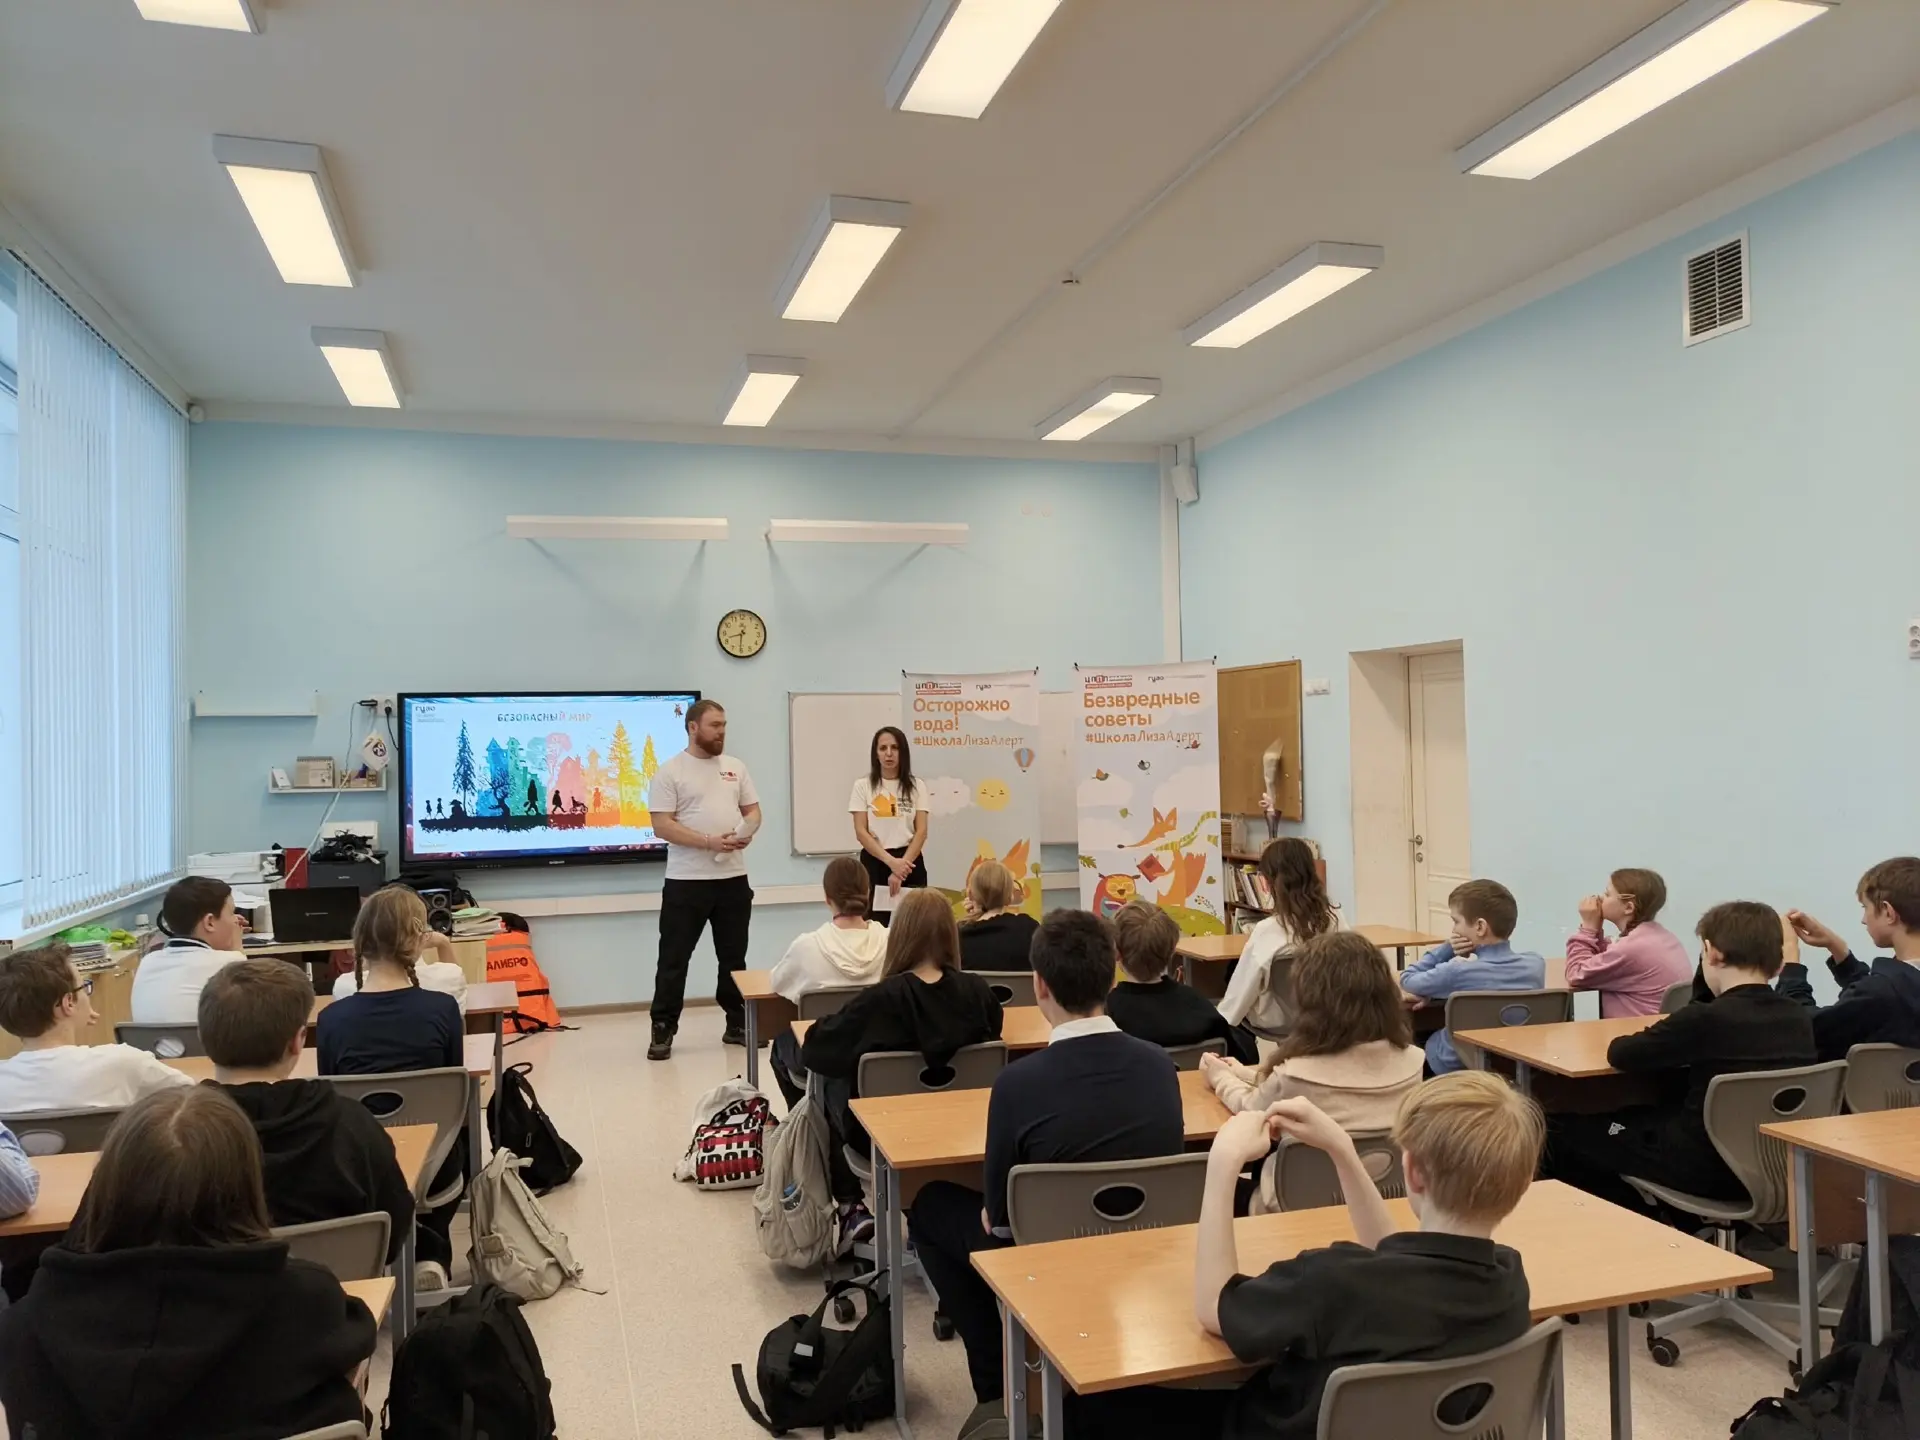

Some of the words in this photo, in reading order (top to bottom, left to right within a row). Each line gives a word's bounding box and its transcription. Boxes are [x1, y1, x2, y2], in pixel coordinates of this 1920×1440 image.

[913, 698, 1010, 714] Осторожно
[1083, 691, 1200, 711] Безвредные
[497, 711, 566, 722] БЕЗОПАСНЫЙ
[568, 712, 592, 722] МИР
[913, 716, 959, 732] вода!
[1085, 713, 1152, 727] советы
[913, 734, 1025, 748] #ШколаЛизаАлерт
[1085, 730, 1203, 746] #ШколаЛизаАлерт
